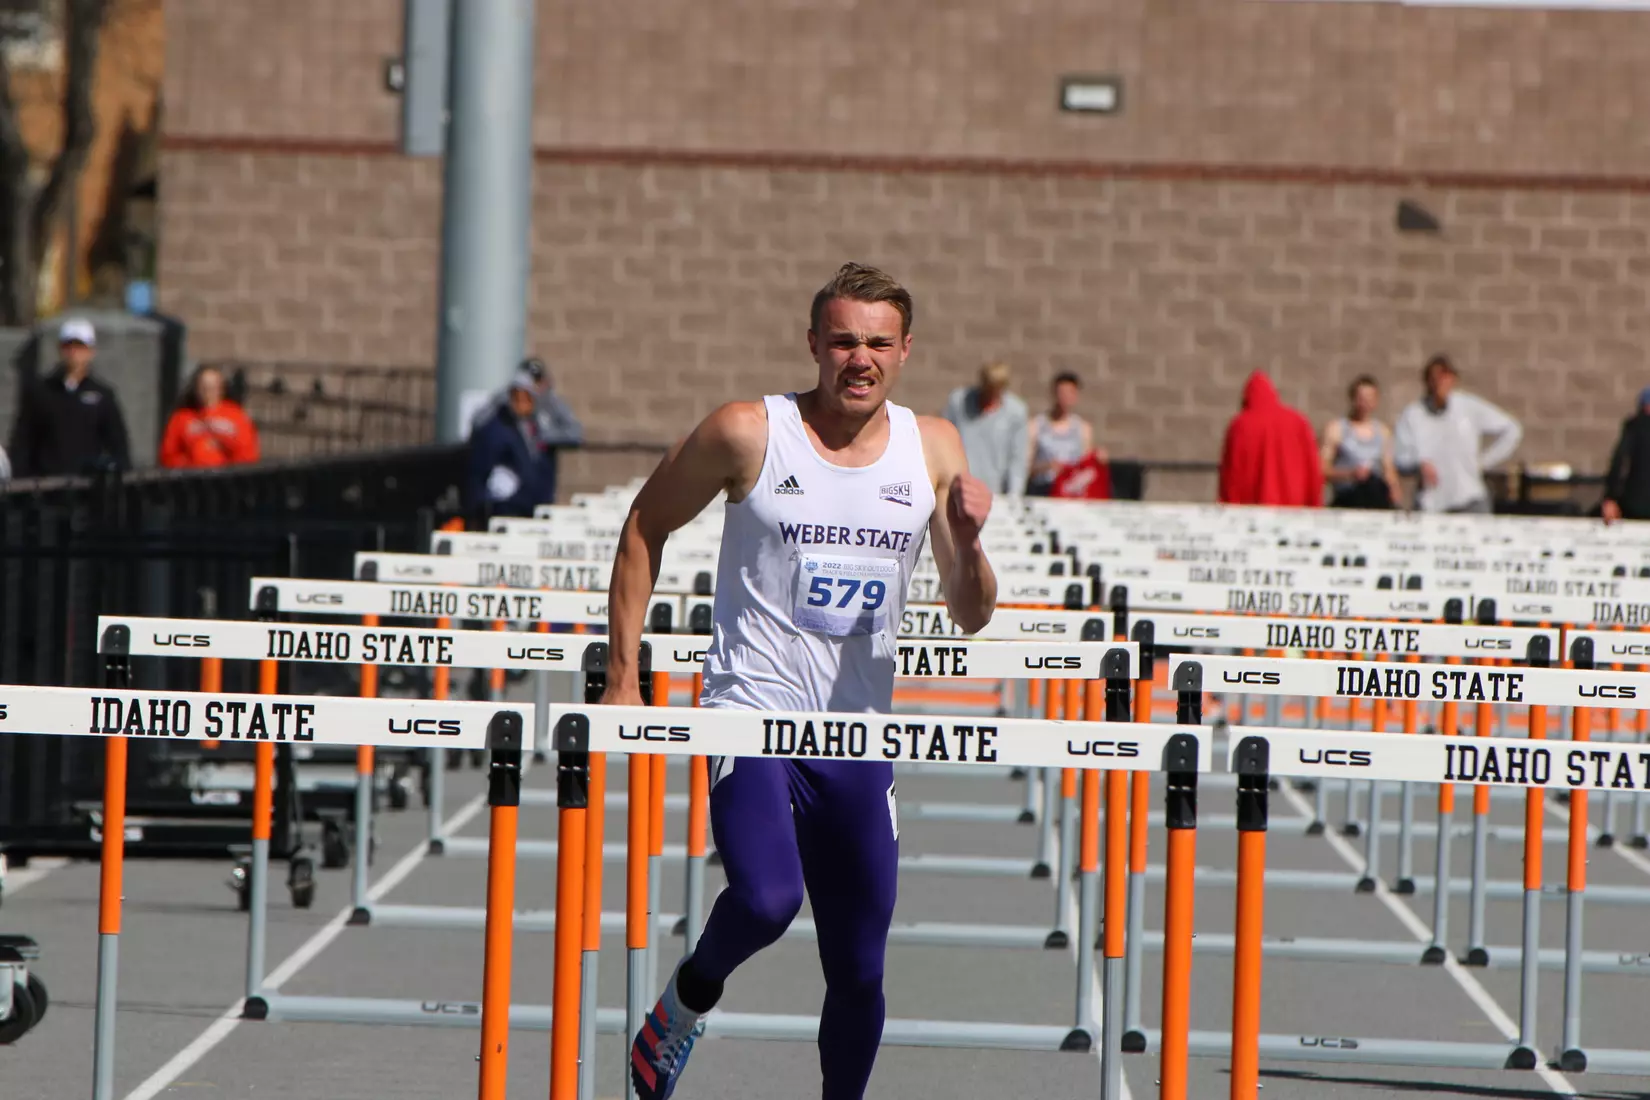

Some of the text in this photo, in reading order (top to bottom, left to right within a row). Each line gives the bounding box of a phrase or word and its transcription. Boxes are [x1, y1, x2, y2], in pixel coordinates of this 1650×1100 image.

[774, 487, 804, 495] adidas
[778, 521, 912, 553] WEBER STATE
[478, 563, 534, 586] IDAHO
[540, 566, 600, 589] STATE
[822, 561, 842, 569] 2022
[296, 589, 542, 619] UCS IDAHO STATE
[807, 576, 886, 610] 579
[1227, 589, 1282, 611] IDAHO
[1289, 592, 1349, 615] STATE
[901, 610, 1067, 635] STAT UCS
[1593, 602, 1650, 623] IDAHO
[154, 629, 564, 665] UCS IDAHO STATE UCS
[1174, 624, 1512, 653] UCS IDAHO STATE UCS
[673, 646, 1082, 676] UC TATE UCS
[1223, 667, 1636, 702] UCS IDAHO STATE UCS
[90, 697, 462, 741] IDAHO STATE UCS
[619, 718, 1140, 762] UCS IDAHO STATE UCS
[1299, 743, 1650, 789] UCS IDAHO STAT
[421, 1000, 479, 1014] UCS
[1300, 1035, 1359, 1050] UCS
